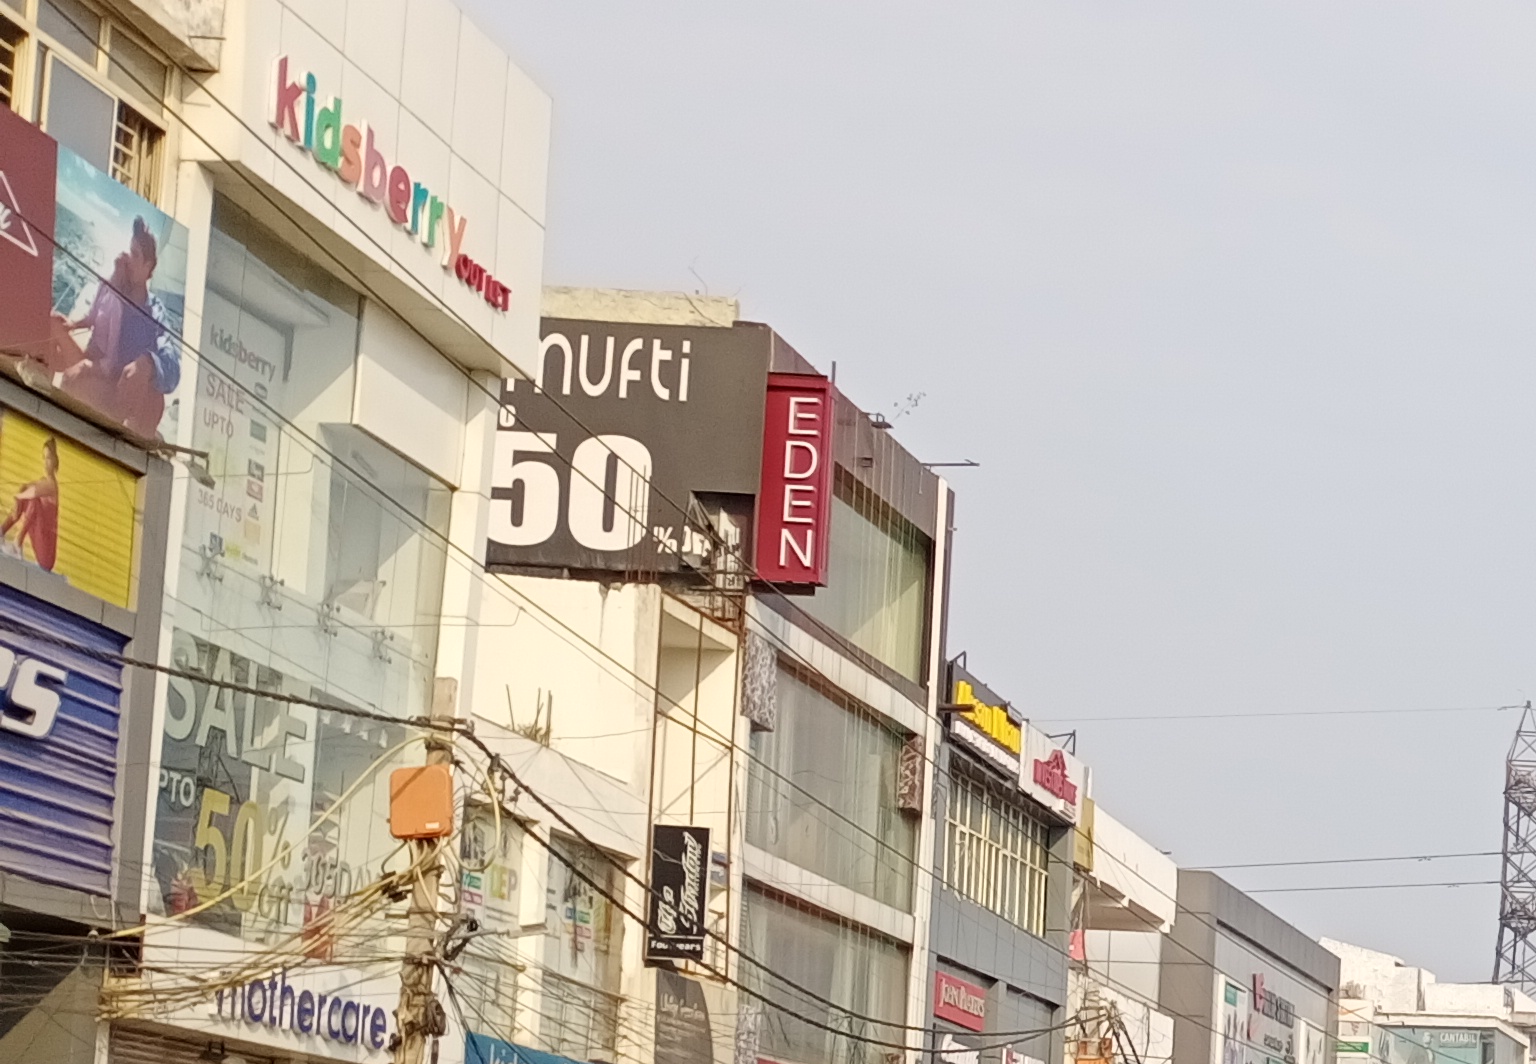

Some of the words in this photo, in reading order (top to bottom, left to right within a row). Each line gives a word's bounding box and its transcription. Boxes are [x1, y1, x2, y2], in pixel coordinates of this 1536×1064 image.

[272, 54, 468, 270] kidsberry
[209, 324, 276, 382] kidsberry
[206, 373, 246, 414] SALE
[216, 491, 243, 523] DAYS
[778, 396, 821, 569] EDEN
[163, 628, 307, 782] SALE
[160, 768, 194, 806] PTO
